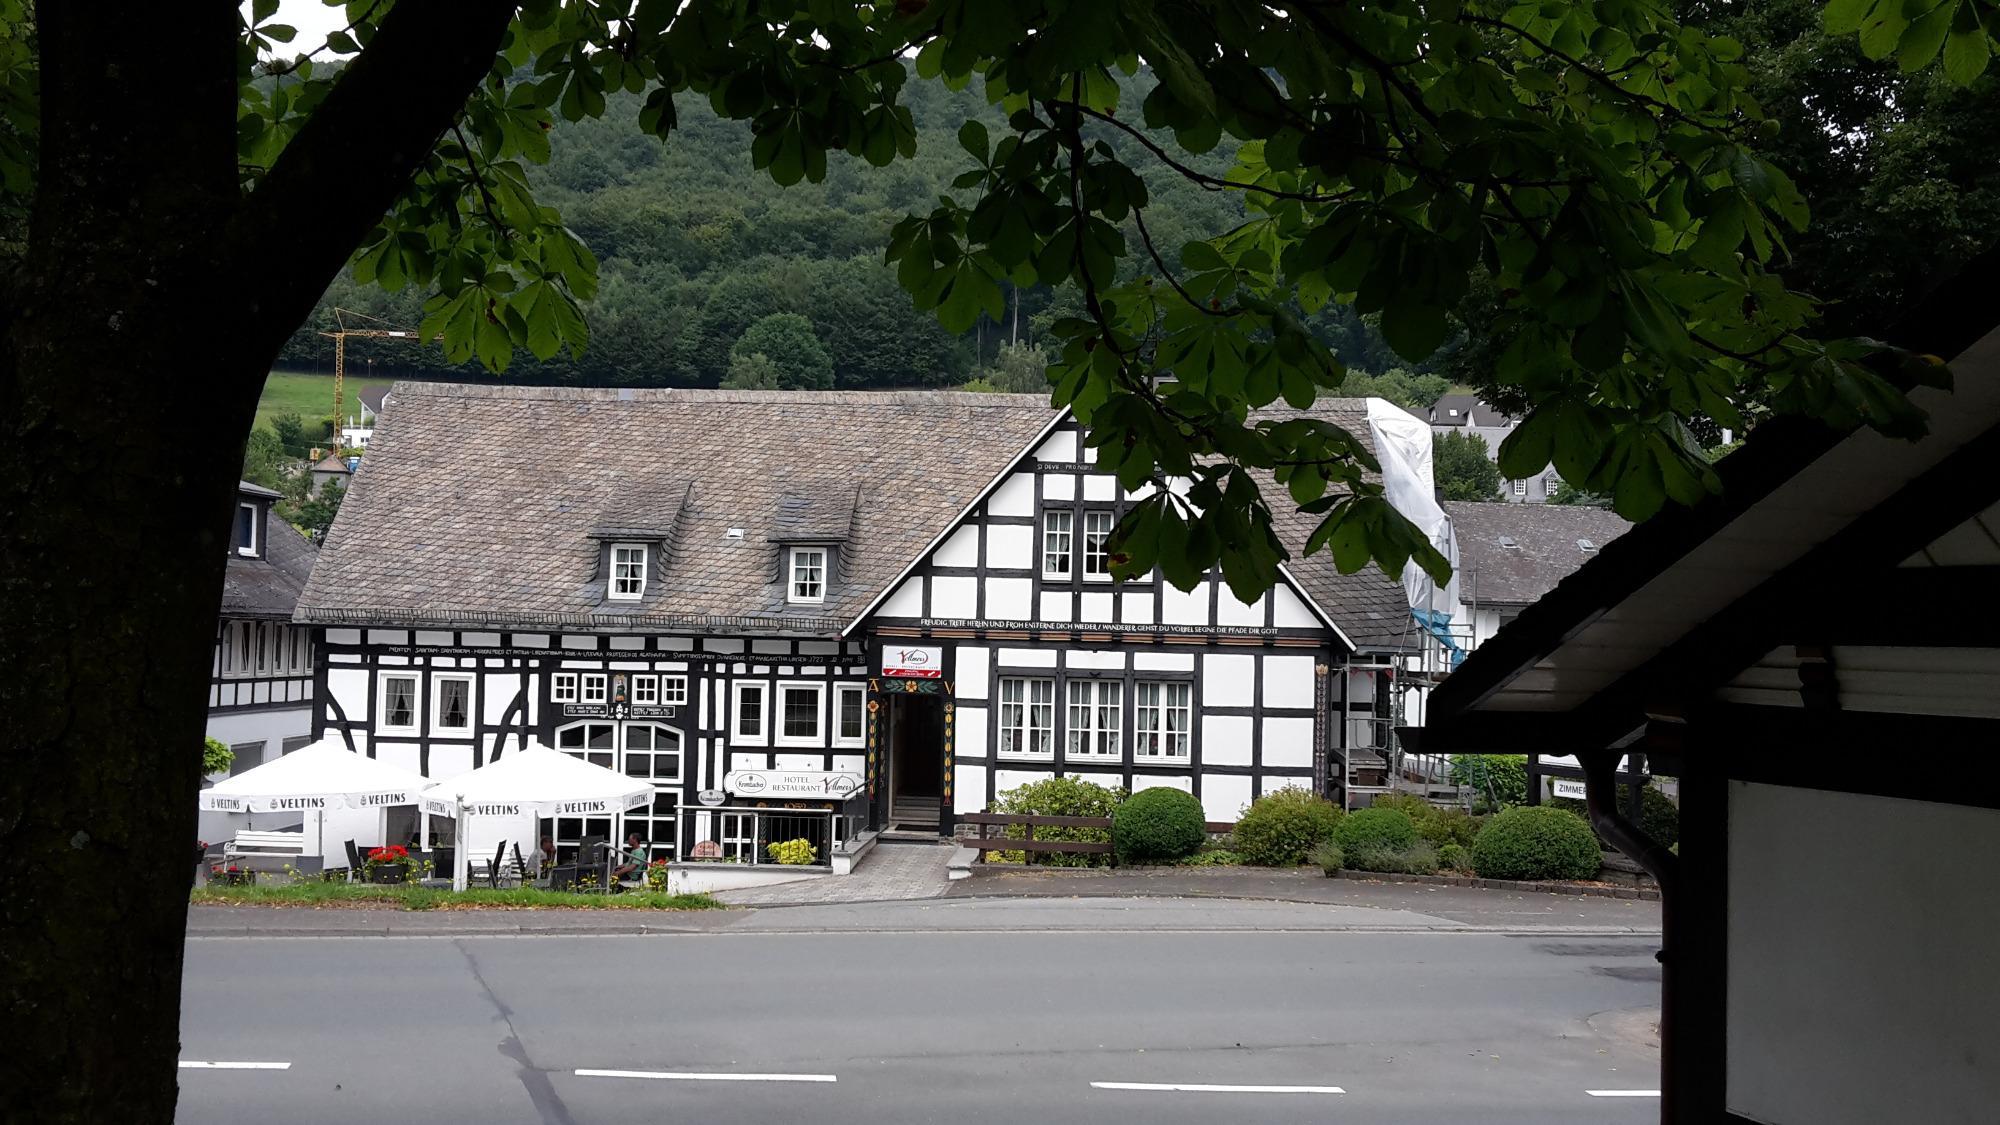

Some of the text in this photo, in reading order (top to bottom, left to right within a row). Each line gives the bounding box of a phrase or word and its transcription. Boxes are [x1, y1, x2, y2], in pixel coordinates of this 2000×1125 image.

[921, 618, 948, 627] FREUDIG
[990, 620, 1005, 629] UND
[1006, 621, 1024, 630] FROH
[1056, 622, 1073, 631] DICH
[1074, 623, 1098, 632] WIEDER
[1159, 625, 1170, 633] DU
[1217, 626, 1227, 634] DIE
[1249, 628, 1261, 636] DIR
[1261, 628, 1279, 636] GOTT
[784, 776, 810, 784] HOTEL
[772, 784, 822, 793] RESTAURANT
[216, 798, 240, 810] VELTINS
[281, 797, 325, 809] VELTINS
[368, 792, 406, 805] VELTINS
[478, 804, 519, 816] VELTINS
[564, 801, 606, 813] VELTINS
